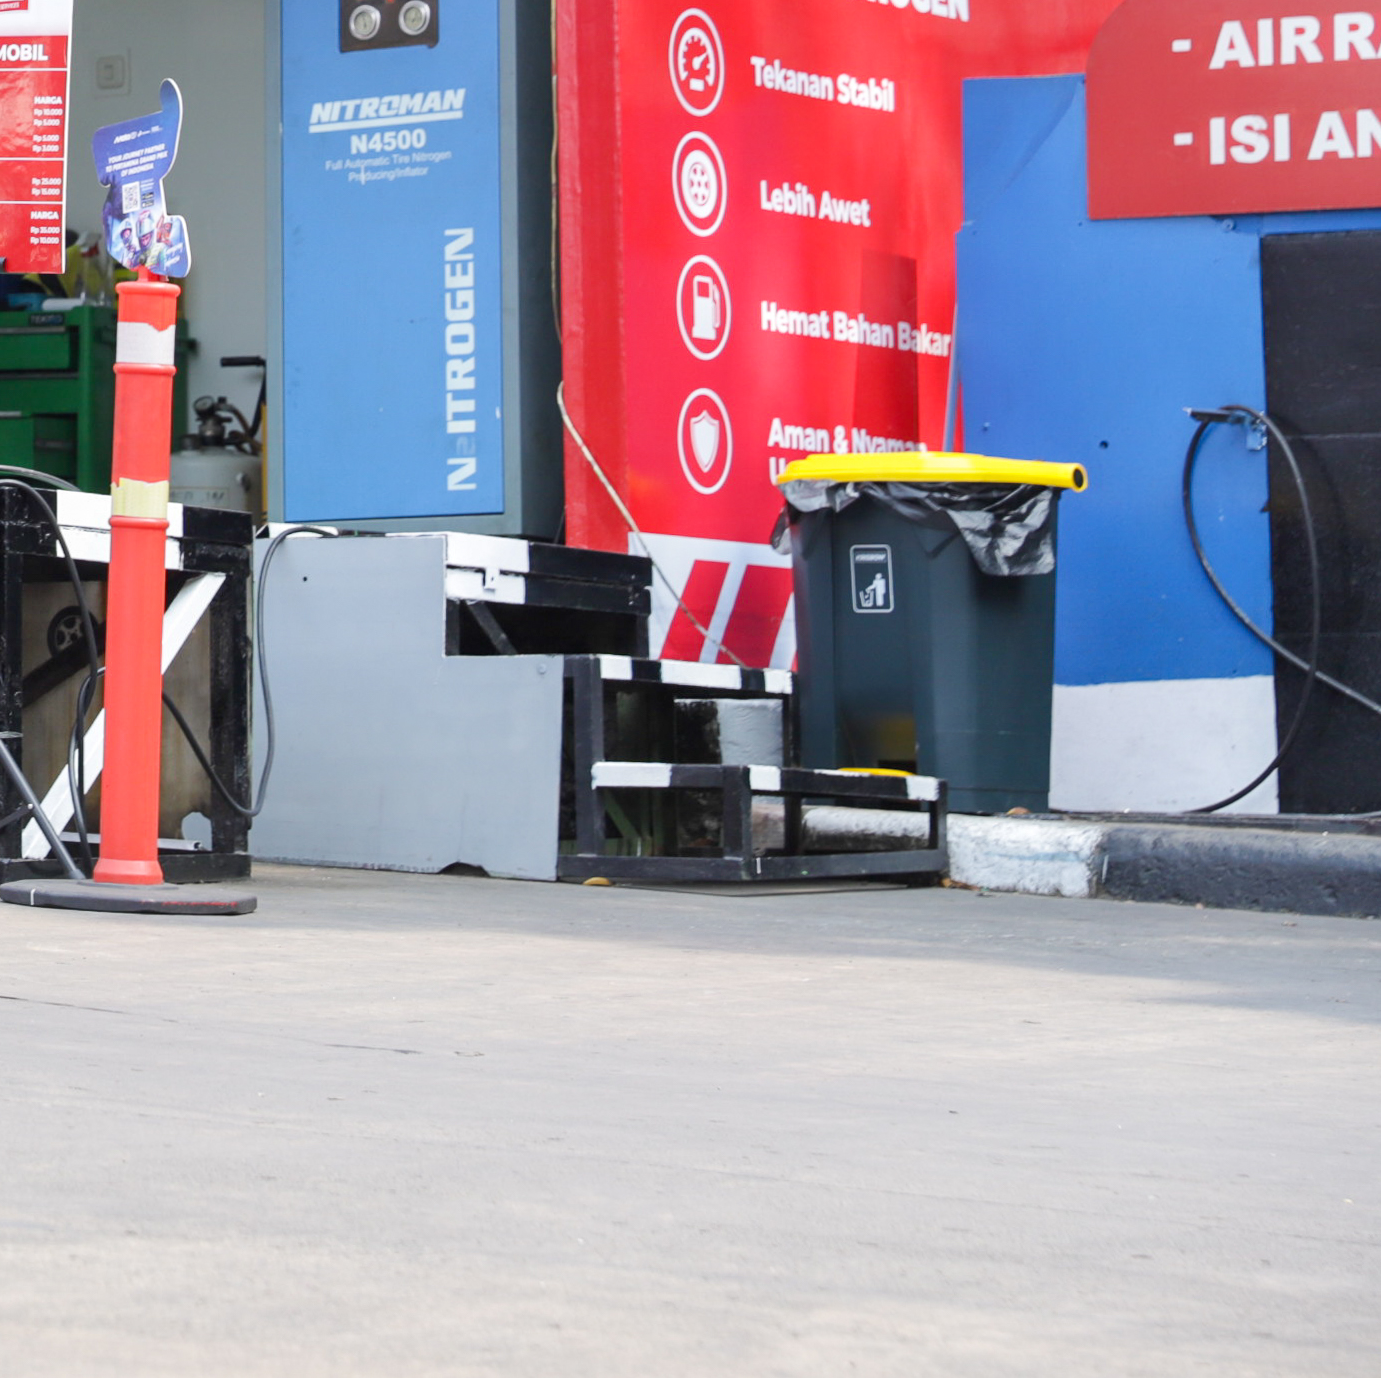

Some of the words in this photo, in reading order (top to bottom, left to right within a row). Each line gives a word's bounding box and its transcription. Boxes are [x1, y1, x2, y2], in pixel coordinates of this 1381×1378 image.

[1208, 15, 1324, 70] AIR
[1334, 11, 1381, 62] R
[33, 96, 63, 105] HARGA
[750, 55, 834, 102] Tekanan
[837, 73, 895, 113] Stabil
[309, 87, 467, 125] NITROMAN
[350, 128, 427, 155] N4500
[1209, 113, 1291, 166] ISI
[325, 159, 343, 171] Full
[344, 155, 390, 169] Automatic
[392, 152, 411, 165] Tire
[412, 150, 453, 164] Nitrogen
[30, 211, 59, 220] HARGA
[760, 179, 816, 218] Lebih
[819, 190, 871, 228] Awet
[761, 300, 830, 340] Hemat
[833, 312, 895, 350] Bahan
[898, 322, 952, 357] Bakar
[767, 417, 830, 453] Aman
[833, 425, 849, 454] &
